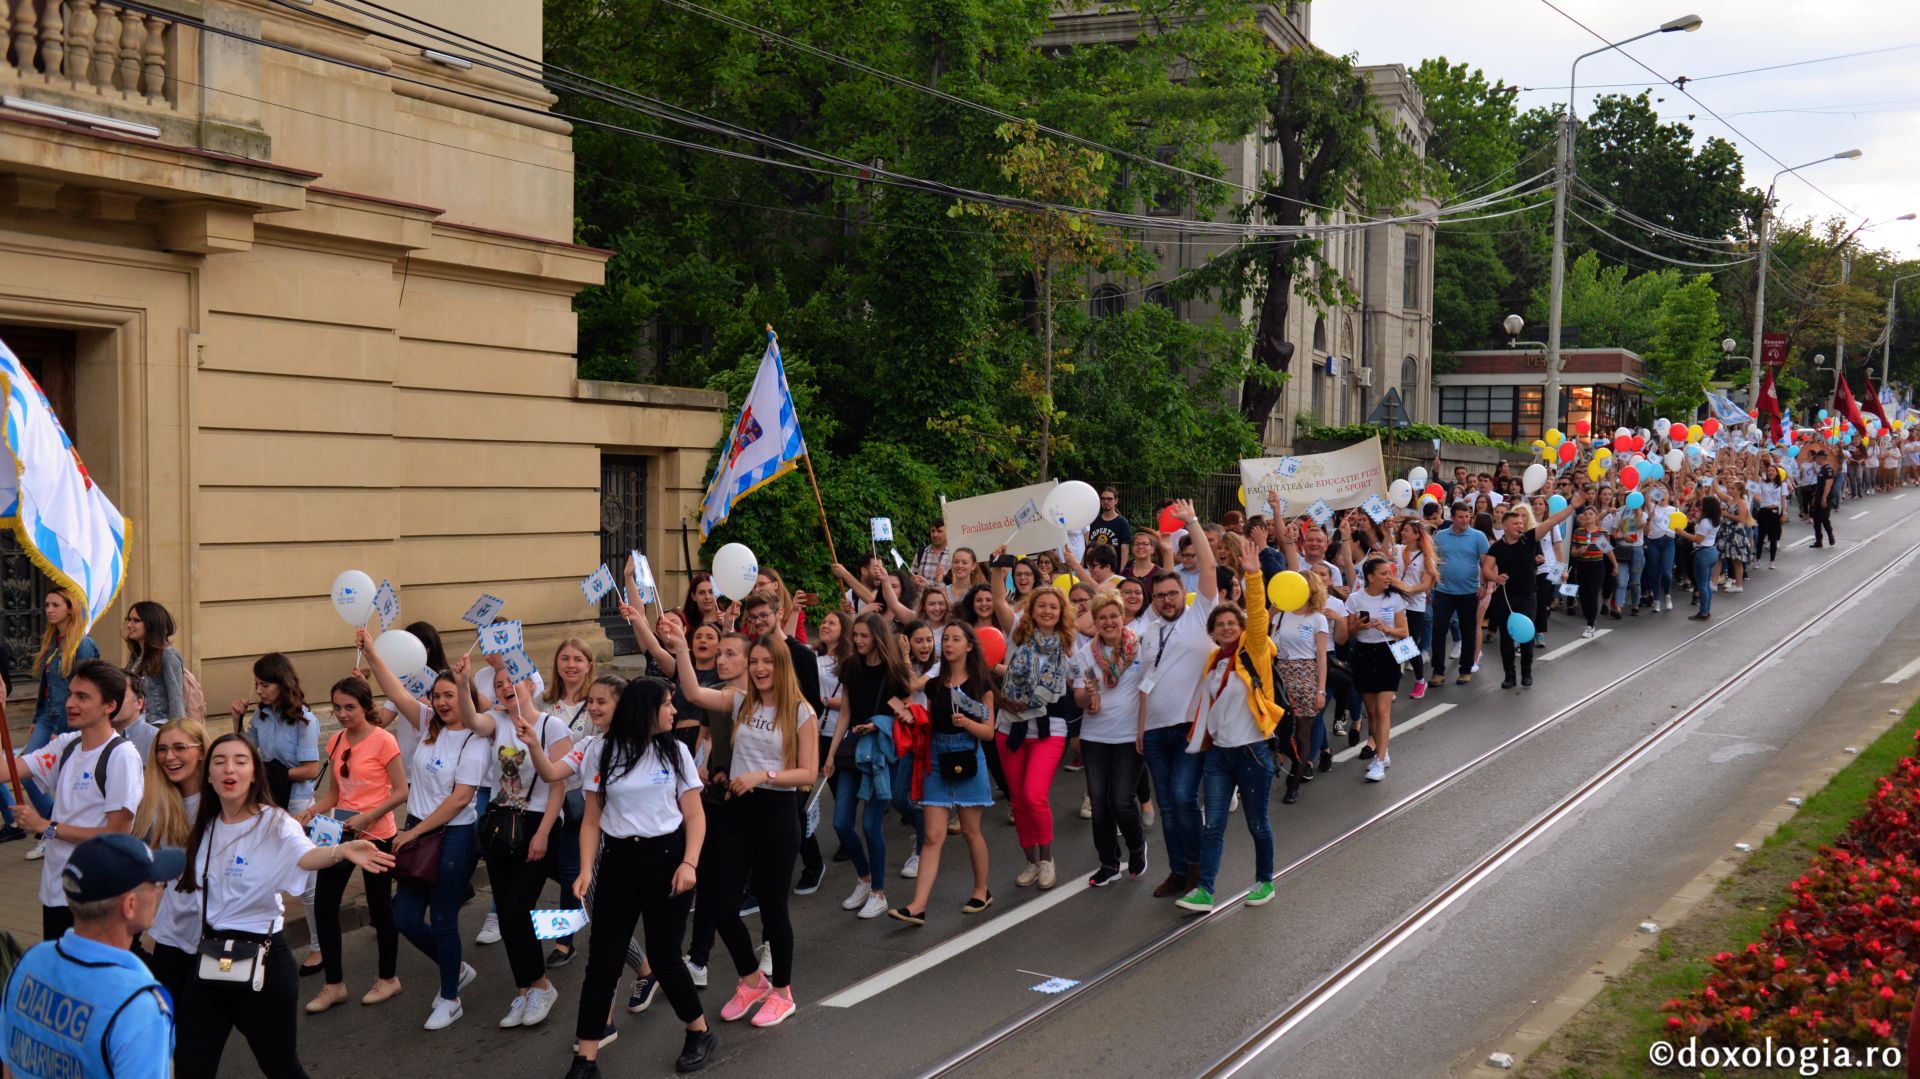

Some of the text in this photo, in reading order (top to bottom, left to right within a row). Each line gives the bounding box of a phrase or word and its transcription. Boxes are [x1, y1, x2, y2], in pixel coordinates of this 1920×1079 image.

[1304, 481, 1313, 489] de
[1345, 479, 1373, 492] SPORT
[961, 519, 1003, 535] Facultatea
[1004, 515, 1015, 528] de
[18, 977, 90, 1038] DIALOG
